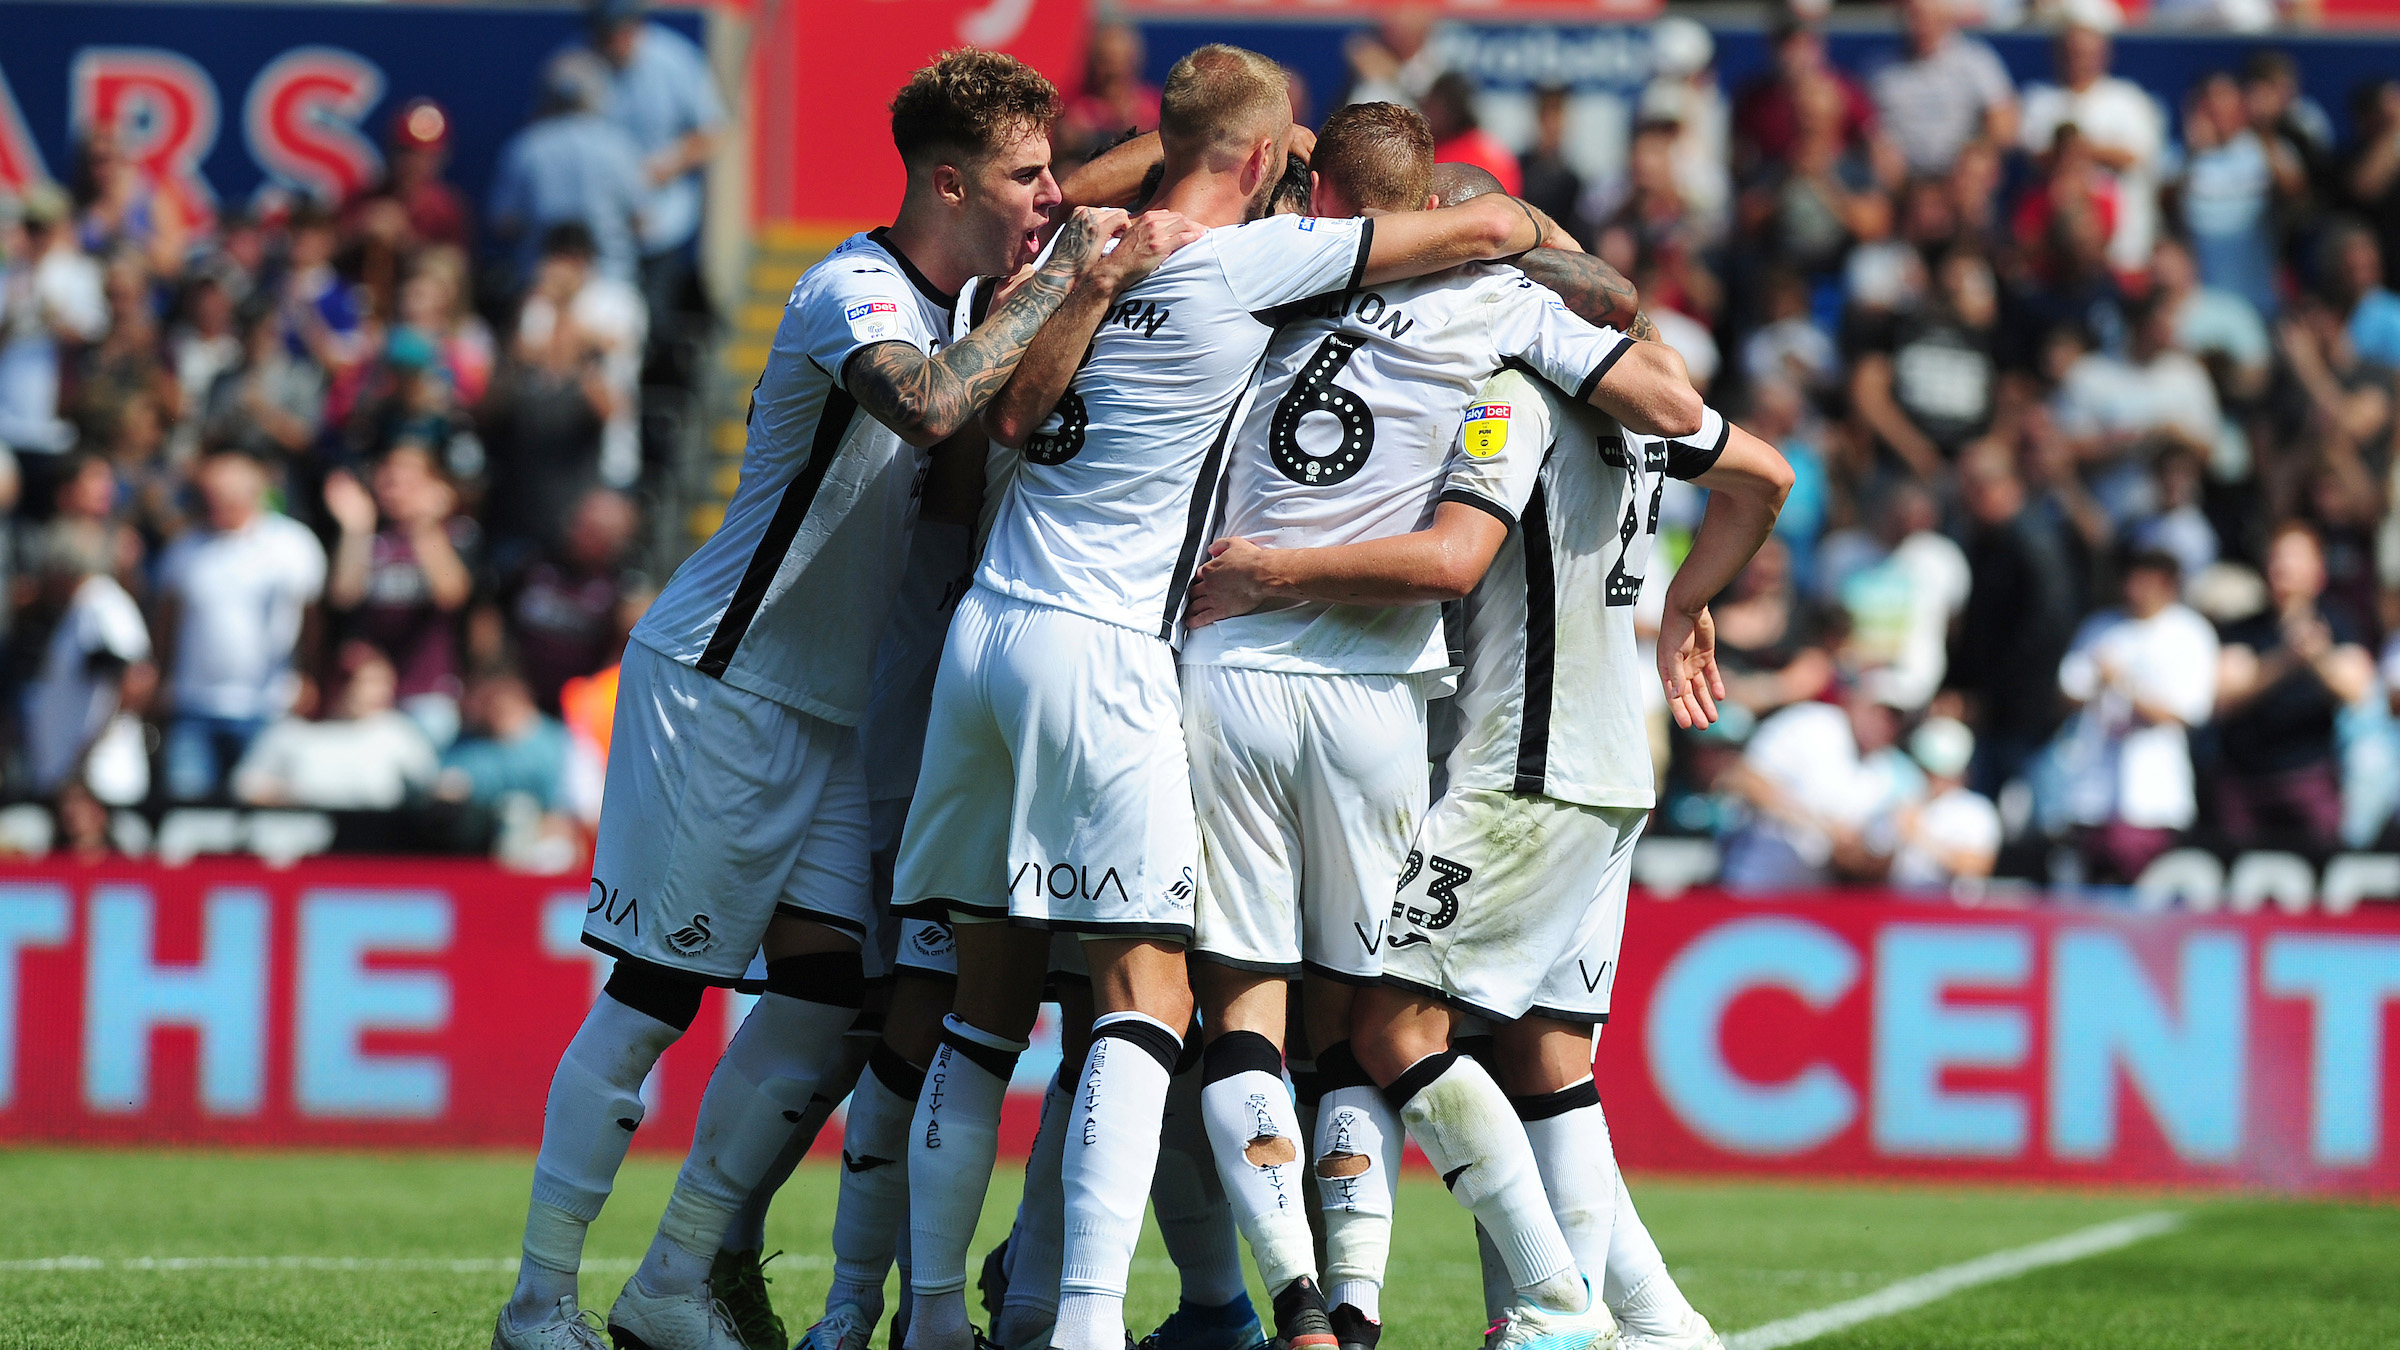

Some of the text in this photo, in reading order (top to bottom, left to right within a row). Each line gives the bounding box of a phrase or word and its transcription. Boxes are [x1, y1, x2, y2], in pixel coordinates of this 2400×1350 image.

[849, 305, 869, 319] sky
[872, 303, 895, 311] bet
[1269, 333, 1376, 487] 6
[1465, 406, 1509, 420] sky bet
[929, 1074, 944, 1115] CITY
[1085, 1079, 1102, 1113] CITY
